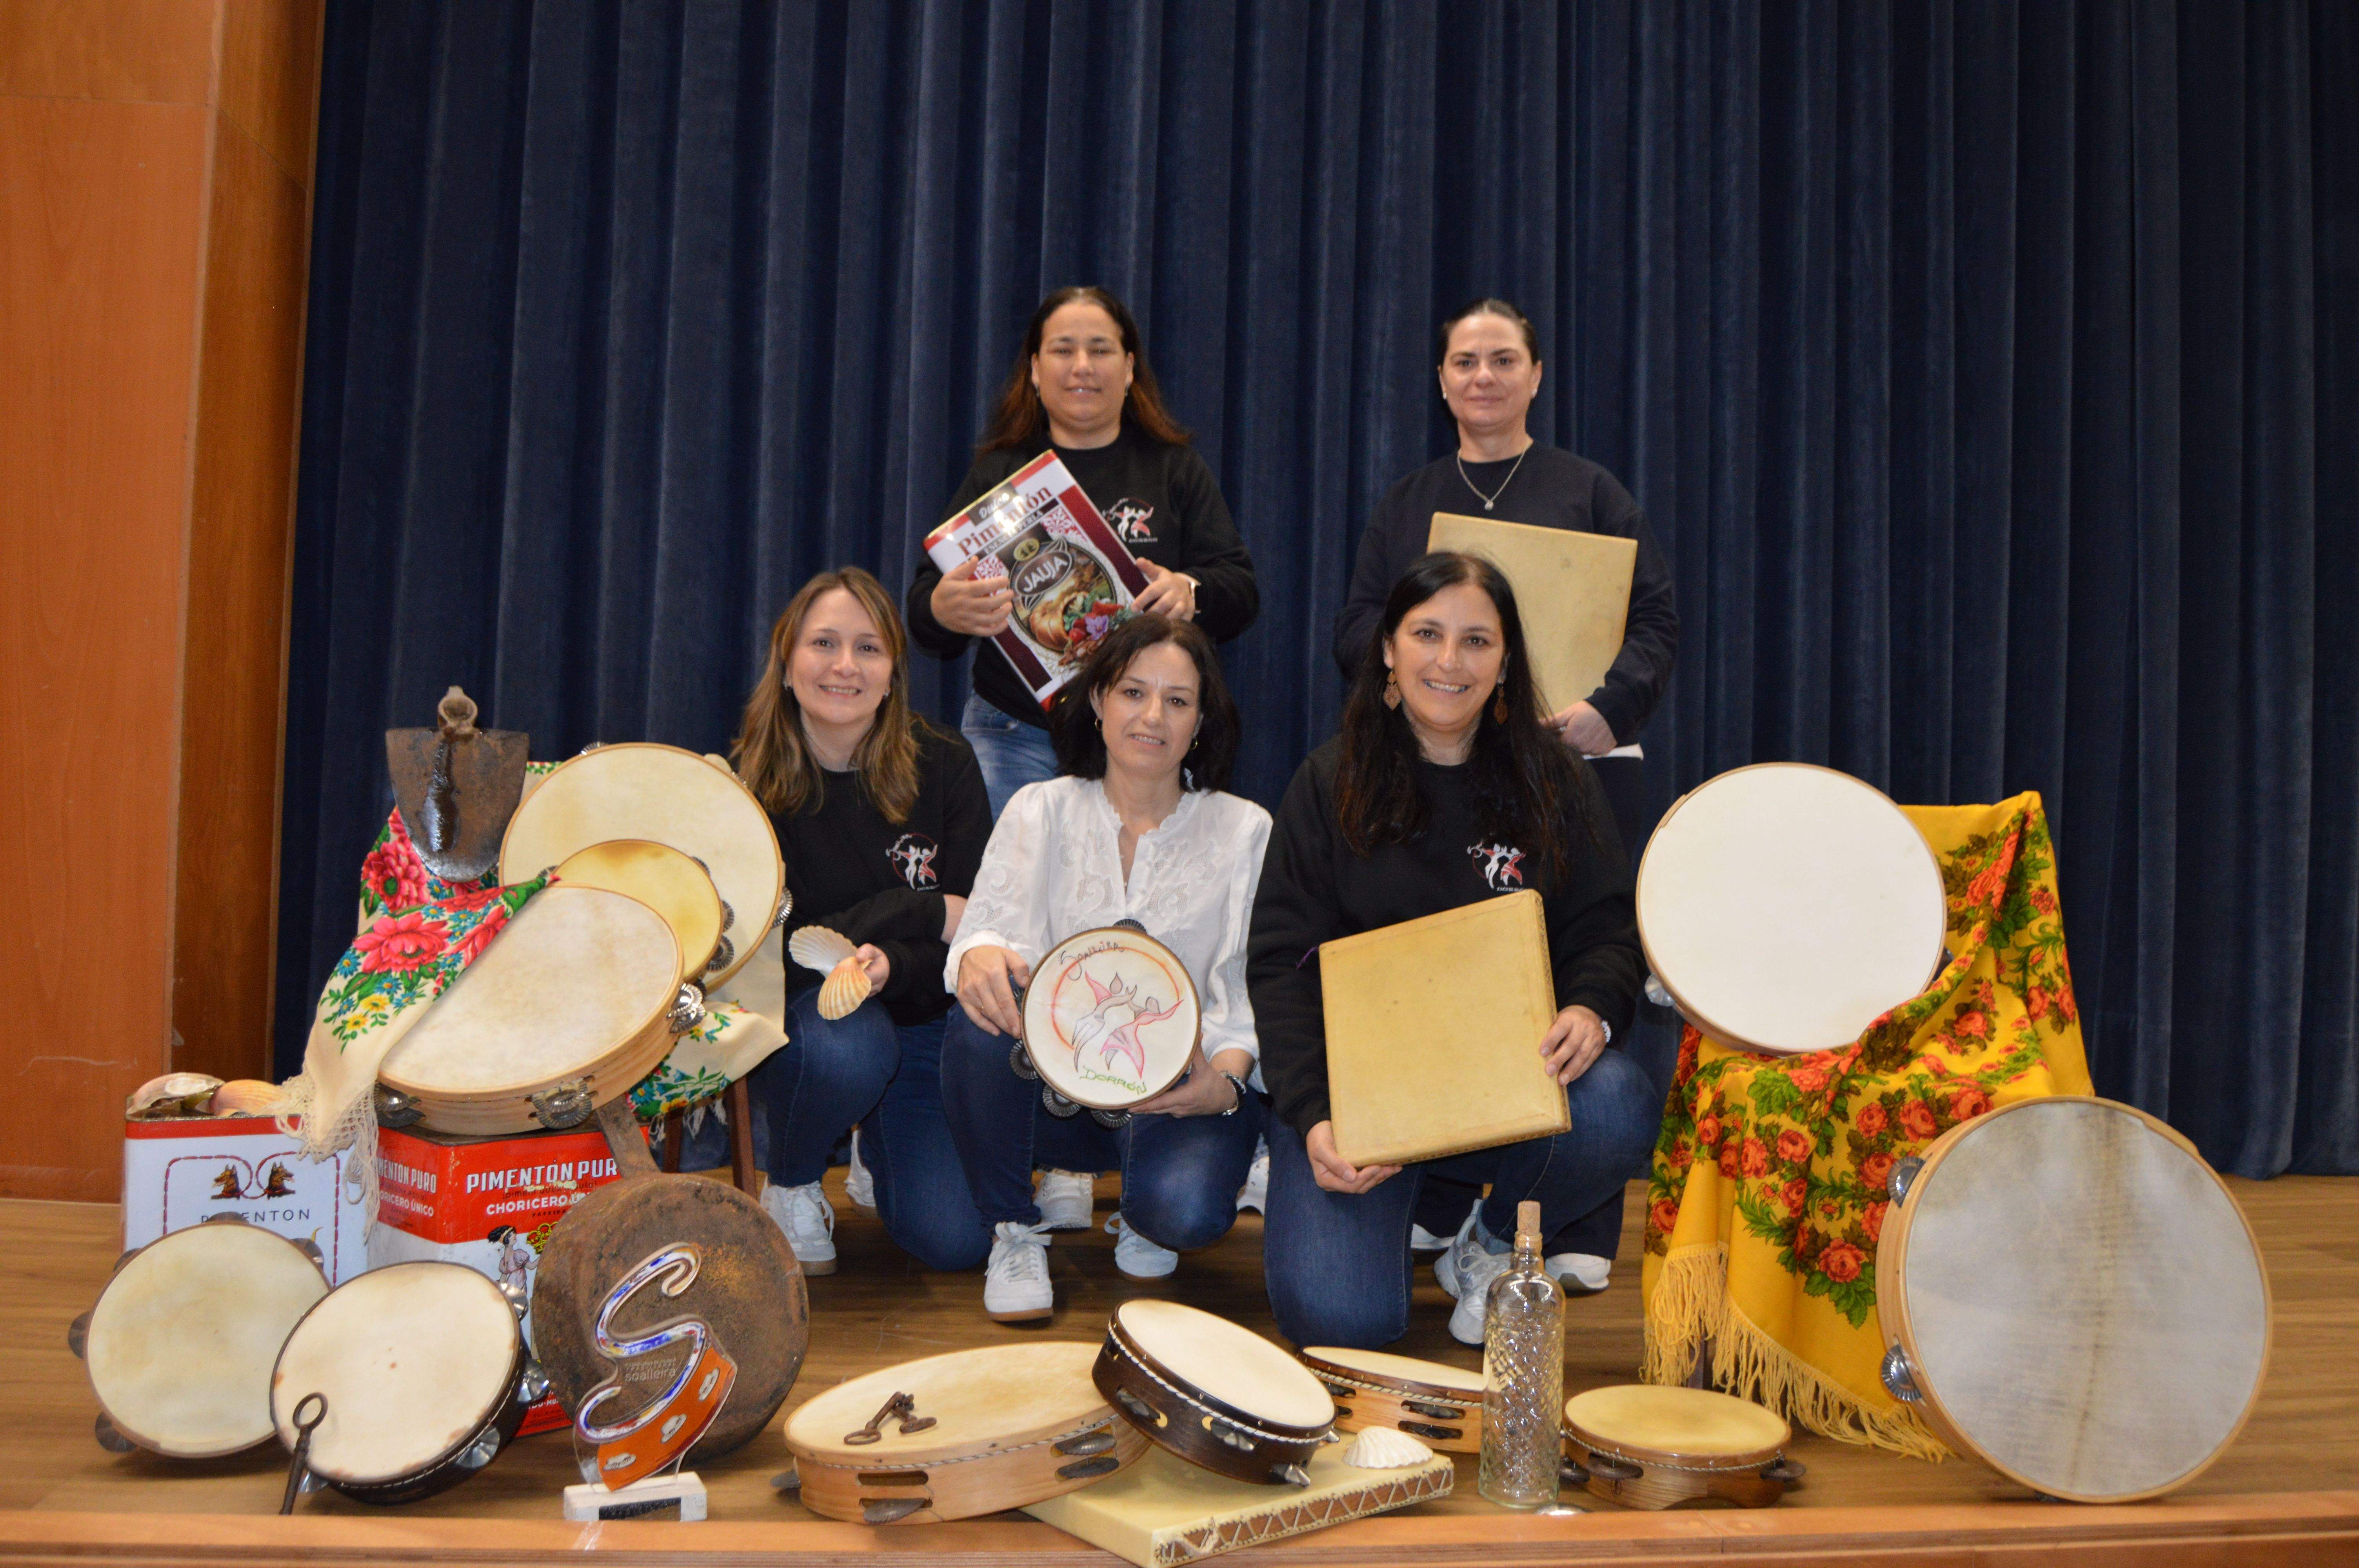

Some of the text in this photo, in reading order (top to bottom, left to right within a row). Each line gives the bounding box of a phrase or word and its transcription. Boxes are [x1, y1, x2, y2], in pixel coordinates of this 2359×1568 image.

[1023, 556, 1068, 593] JAUJA
[411, 1168, 437, 1194] PURO
[466, 1158, 617, 1194] PIMENTÓN PUR
[201, 1209, 309, 1223] PENTON
[380, 1190, 410, 1209] ORICERO
[411, 1198, 434, 1217] ÚNICO
[486, 1195, 568, 1216] CHORICERO
